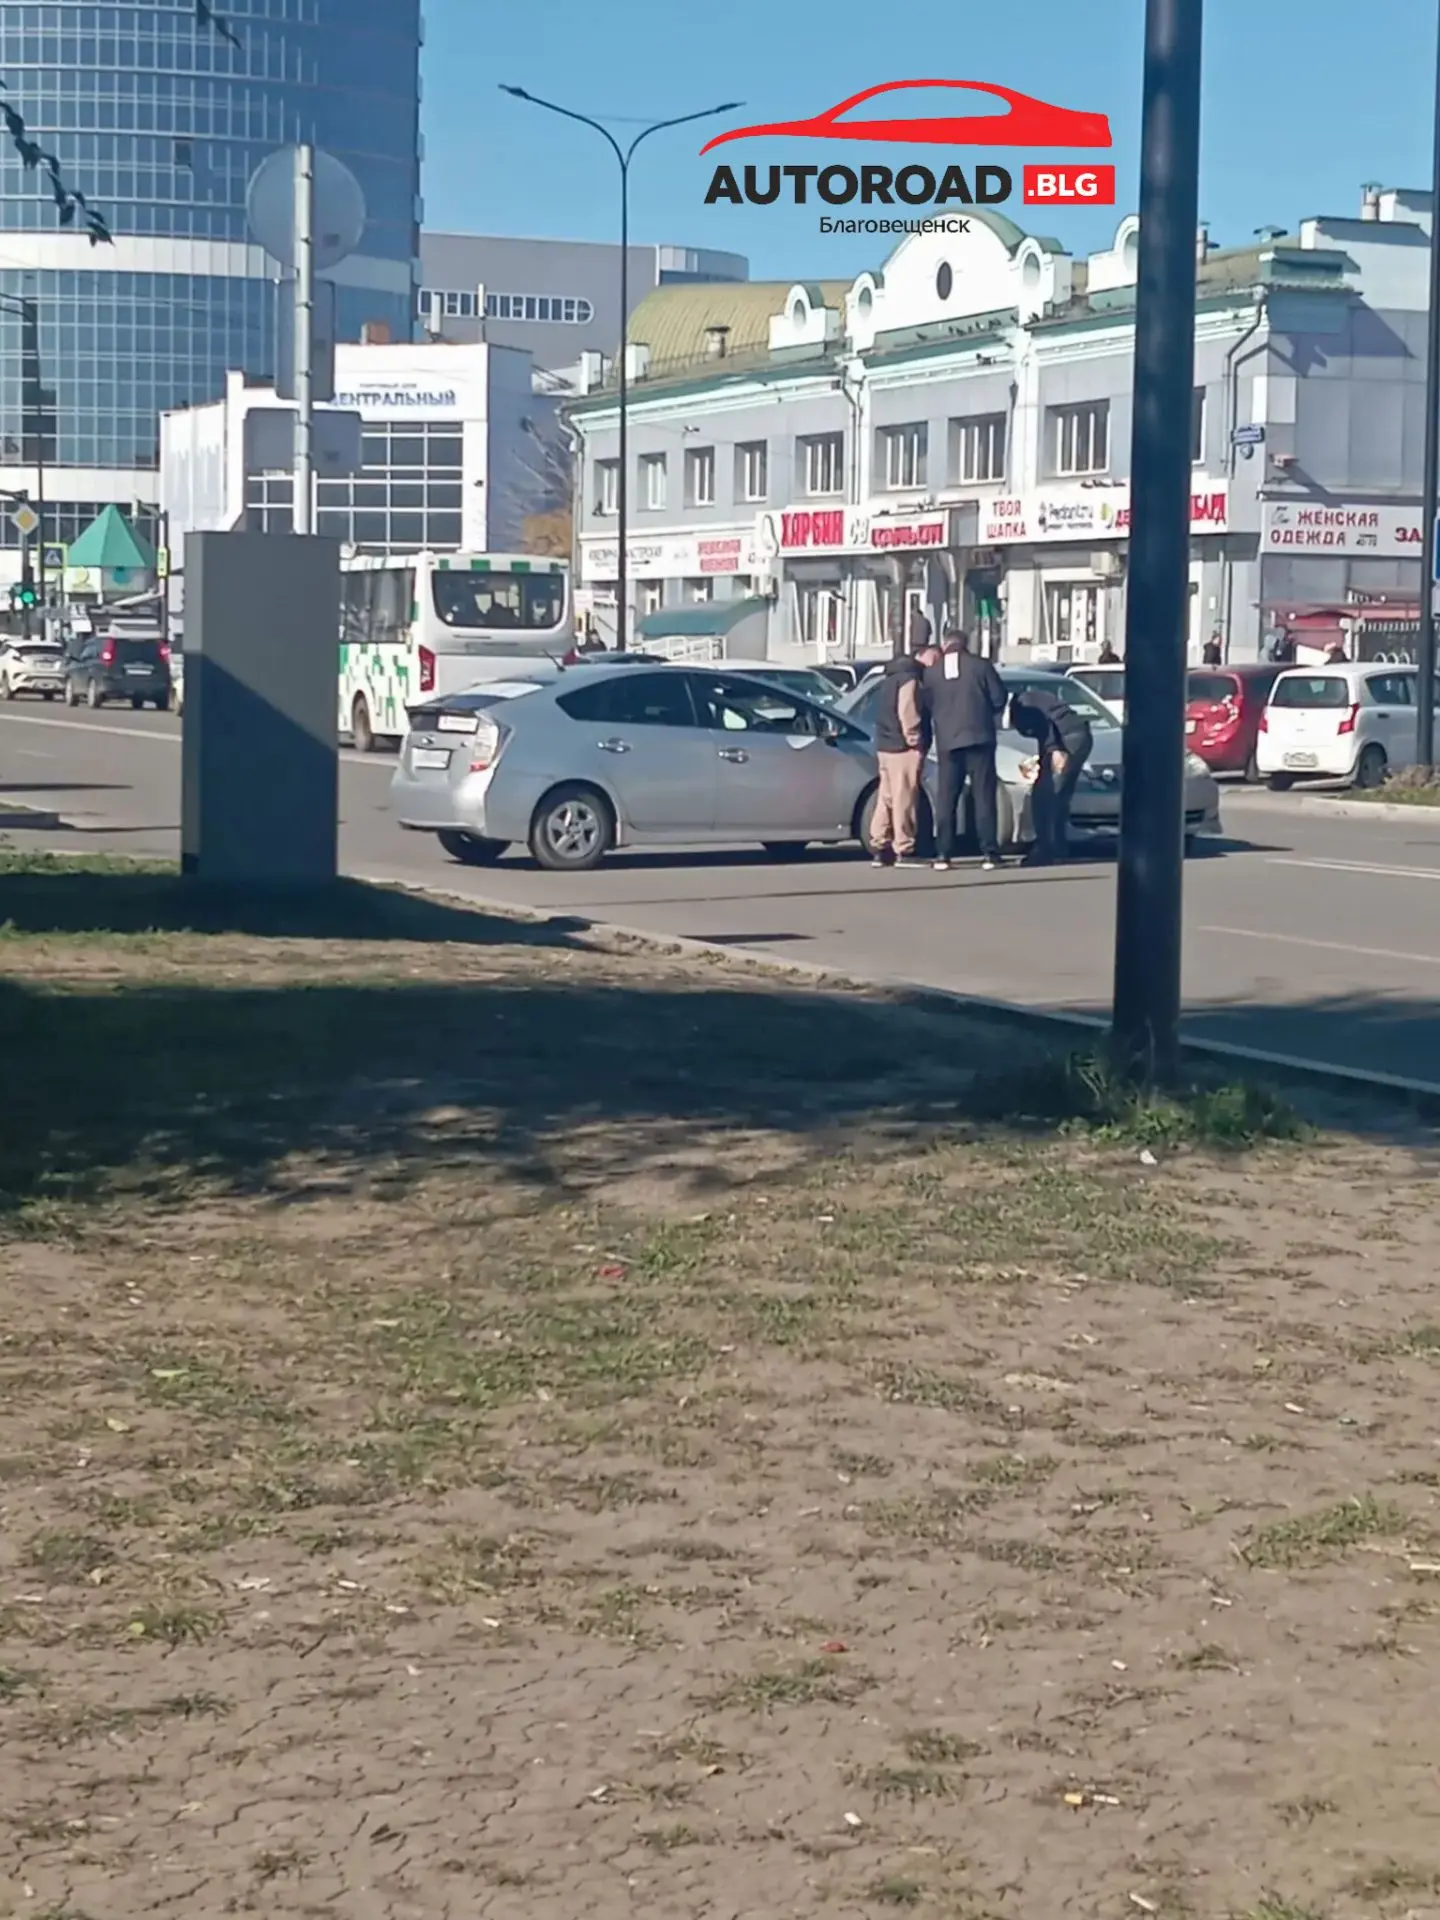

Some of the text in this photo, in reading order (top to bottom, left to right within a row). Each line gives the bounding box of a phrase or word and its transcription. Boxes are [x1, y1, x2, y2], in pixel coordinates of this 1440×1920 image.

[992, 500, 1022, 517] ТВОЯ
[1189, 493, 1227, 525] БАРД
[1297, 509, 1379, 527] ЖЕНСКАЯ
[986, 521, 1027, 539] ШАПКА
[1270, 529, 1346, 546] ОДЕЖДА
[1394, 527, 1423, 543] ЗА
